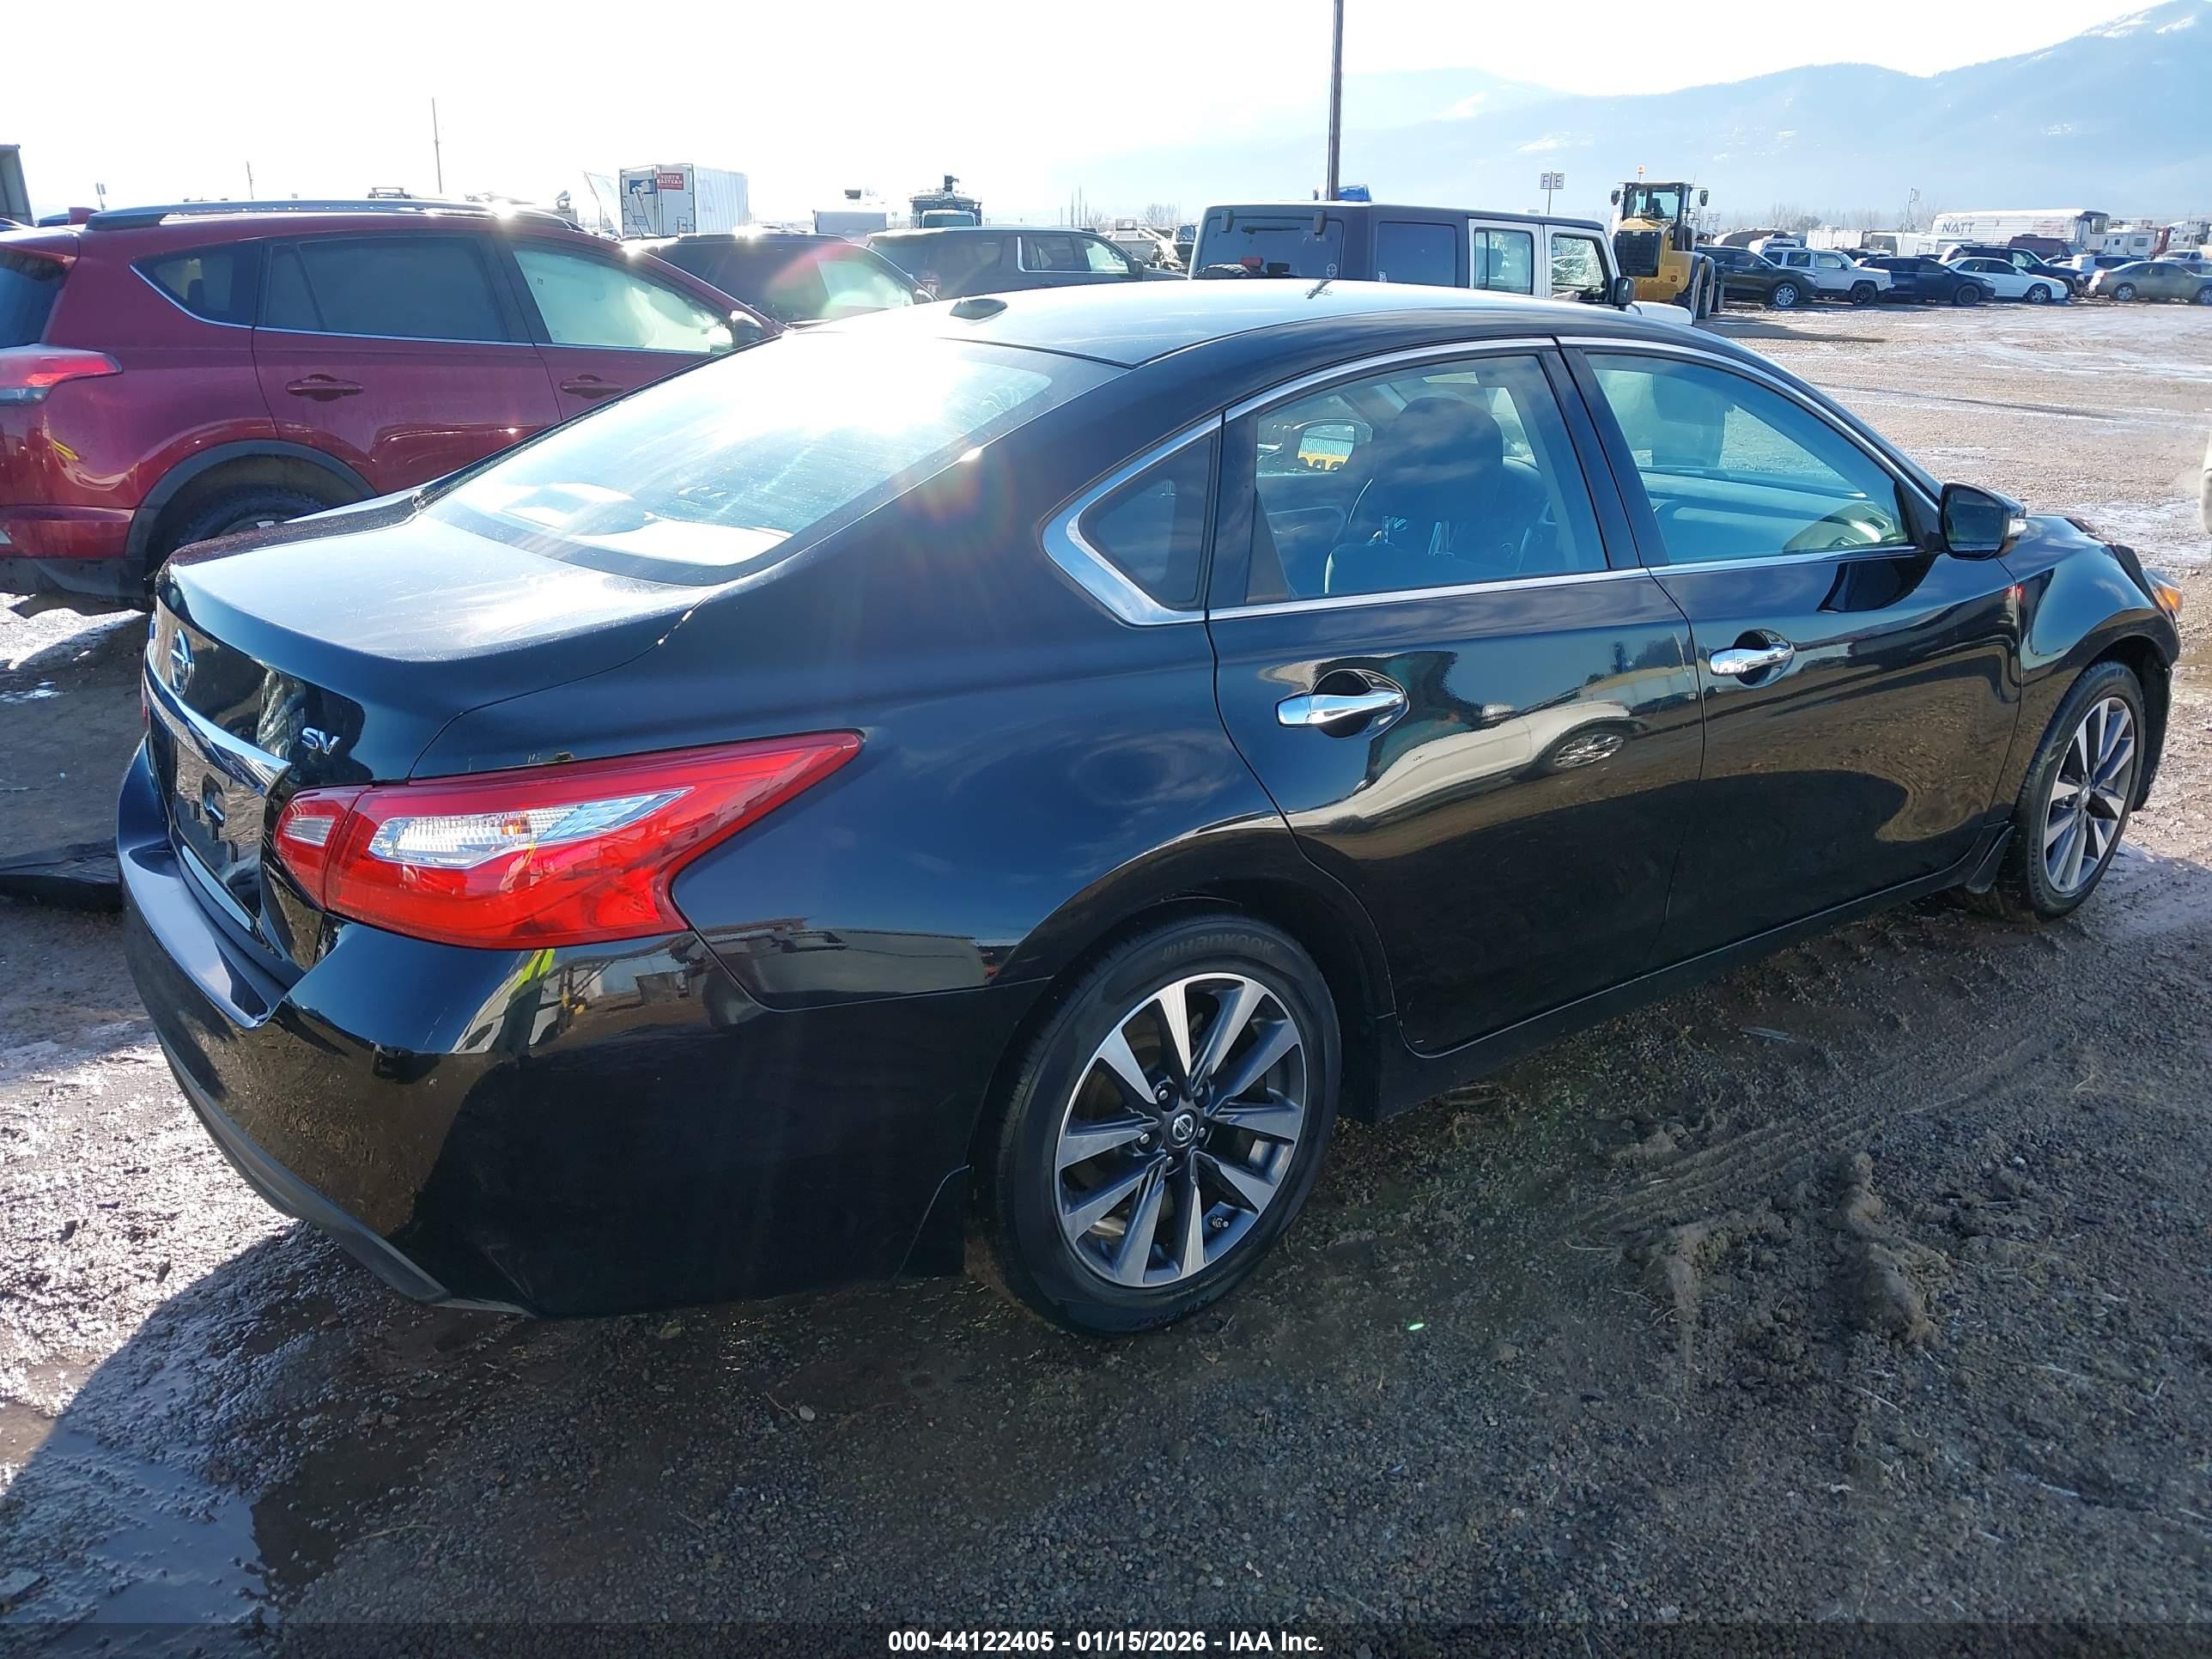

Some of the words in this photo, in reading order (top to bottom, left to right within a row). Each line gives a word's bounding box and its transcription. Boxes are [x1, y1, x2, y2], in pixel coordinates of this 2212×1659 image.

[1543, 175, 1549, 187] F
[1556, 175, 1563, 187] E
[301, 727, 341, 756] SV
